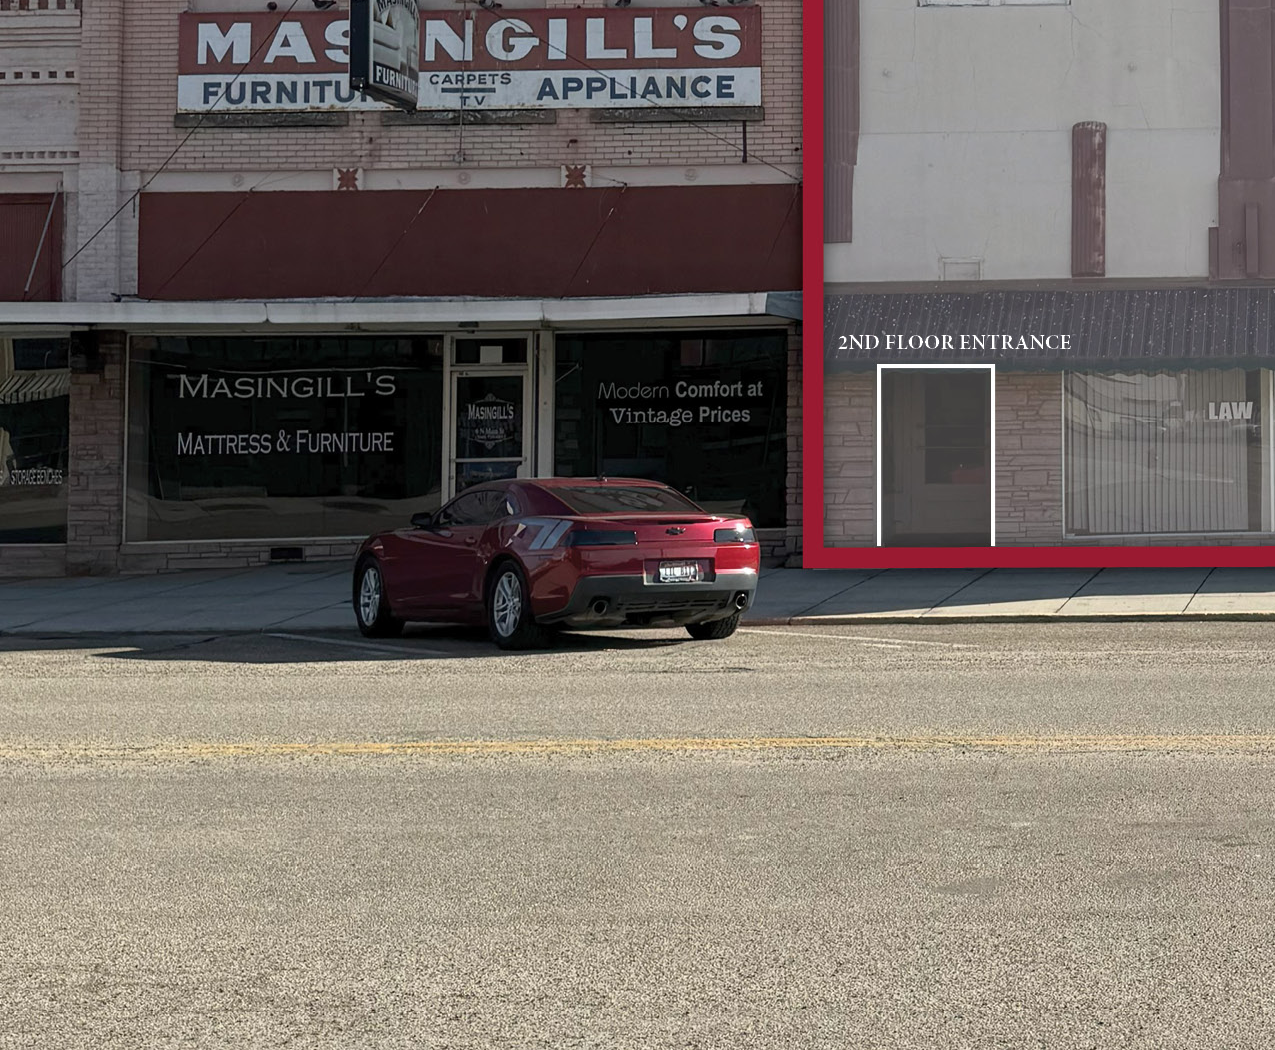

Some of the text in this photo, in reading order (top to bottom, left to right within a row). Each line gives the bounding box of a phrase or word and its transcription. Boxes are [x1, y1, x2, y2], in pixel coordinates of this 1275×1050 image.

[197, 14, 741, 65] MASNGILL'S
[429, 73, 511, 86] CARPETS
[536, 75, 735, 101] APPLIANCE
[203, 80, 366, 104] FURNITU
[459, 95, 486, 107] TV
[179, 372, 397, 399] MASINGILL'S
[598, 380, 764, 399] Modern Comfort at
[468, 403, 514, 420] MASINGILL'S
[609, 405, 751, 427] Vintage Prices
[1208, 401, 1254, 420] LAW
[177, 429, 394, 456] MATTRESS & FURNITURE
